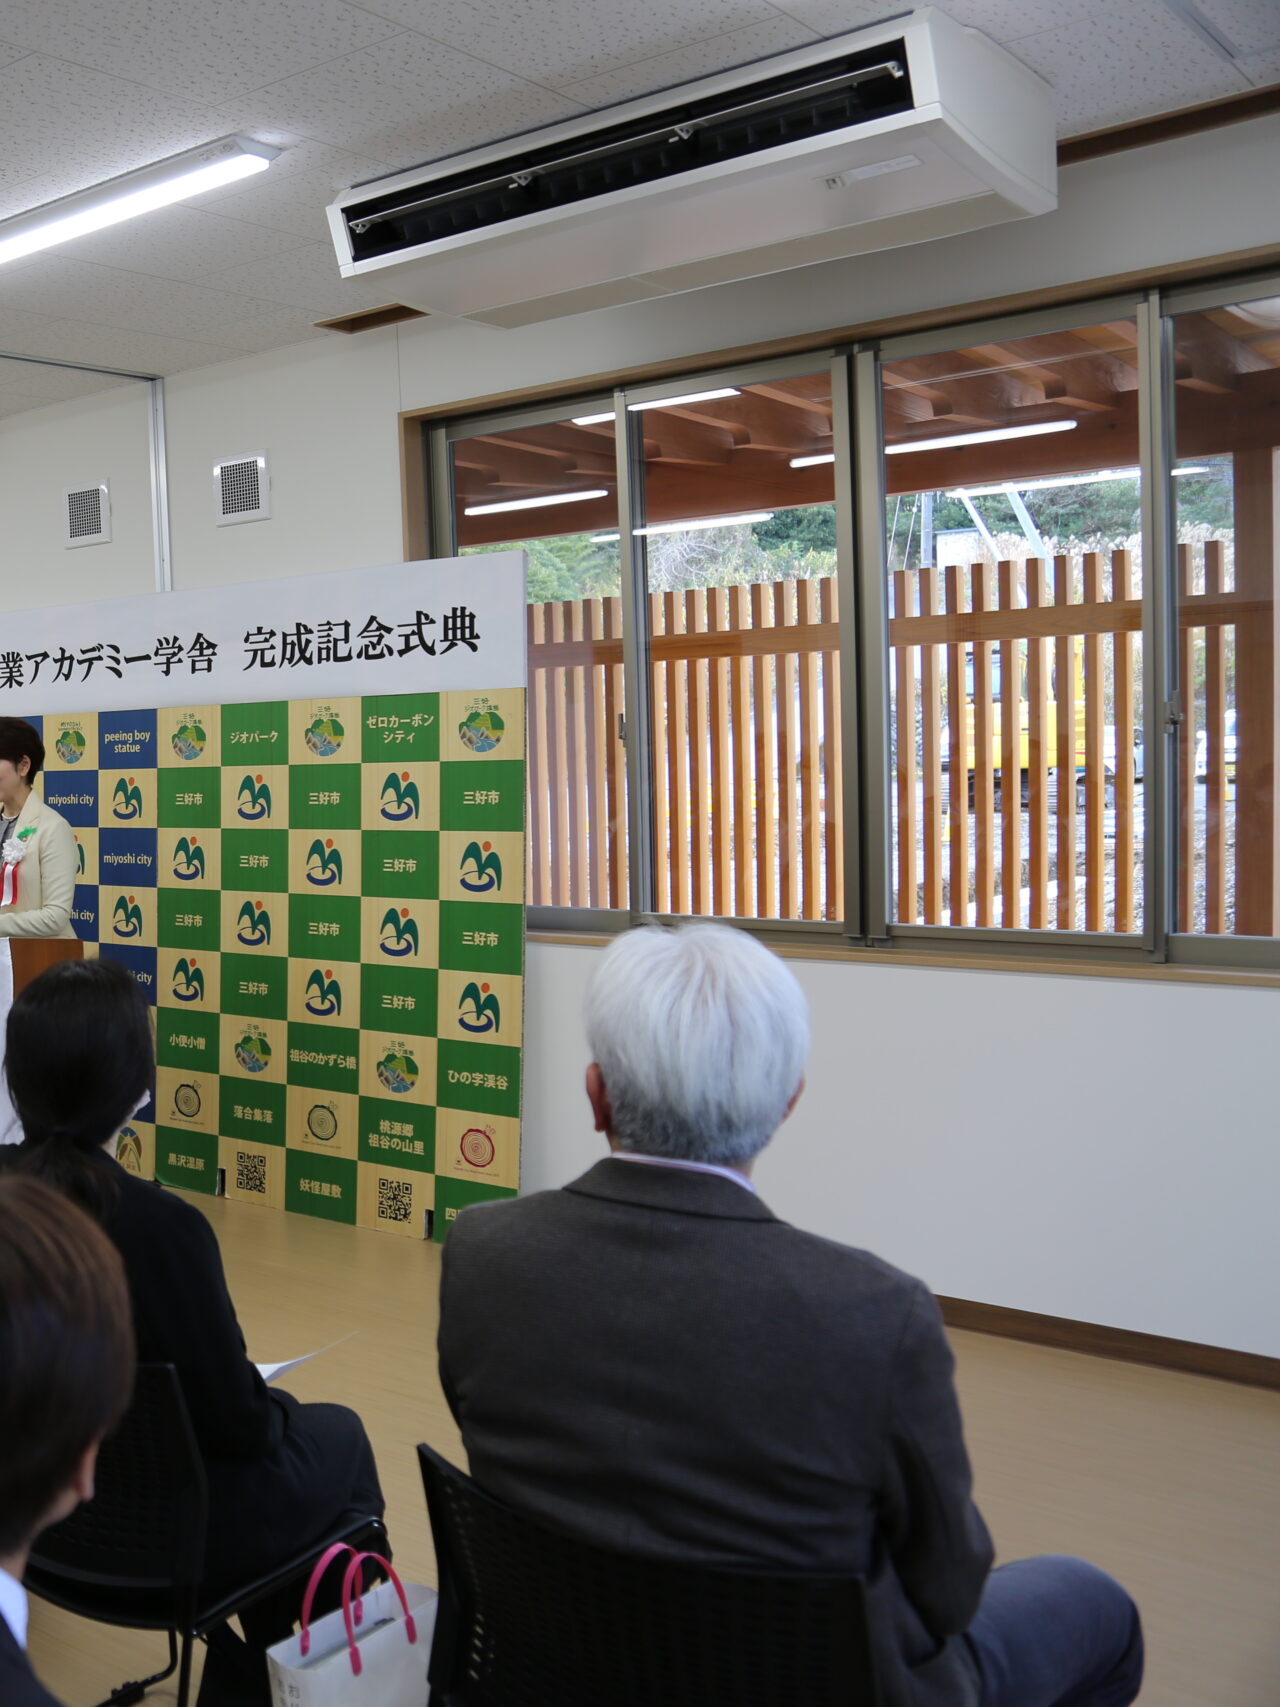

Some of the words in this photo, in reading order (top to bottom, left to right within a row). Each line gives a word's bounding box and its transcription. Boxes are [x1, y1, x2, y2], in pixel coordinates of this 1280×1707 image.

[243, 606, 480, 671] 完成記念式典
[366, 713, 435, 729] ゼロカーボン
[104, 731, 133, 745] peeing
[134, 730, 151, 744] boy
[230, 731, 279, 744] ジオパーク
[383, 730, 416, 744] シティ
[114, 743, 141, 754] statue
[48, 795, 78, 807] miyoshi
[79, 794, 94, 806] city
[175, 793, 204, 806] 三好市
[308, 791, 341, 806] 三好市
[463, 790, 500, 805] 三好市
[103, 853, 136, 867] miyoshi
[136, 854, 153, 868] city
[239, 855, 270, 868] 三好市
[382, 859, 417, 873] 三好市
[79, 910, 95, 923] city
[175, 914, 204, 927] 三好市
[308, 922, 341, 937] 三好市
[462, 931, 500, 947] 三好市
[136, 971, 153, 985] city
[238, 981, 269, 996] 三好市
[381, 995, 416, 1010] 三好市
[169, 1034, 206, 1050] 小便小僧
[289, 1048, 357, 1070] 祖谷のかずら橋
[447, 1070, 509, 1091] ひの字渓谷
[379, 1119, 414, 1138] 桃源郷
[368, 1133, 425, 1156] 祖谷の山里
